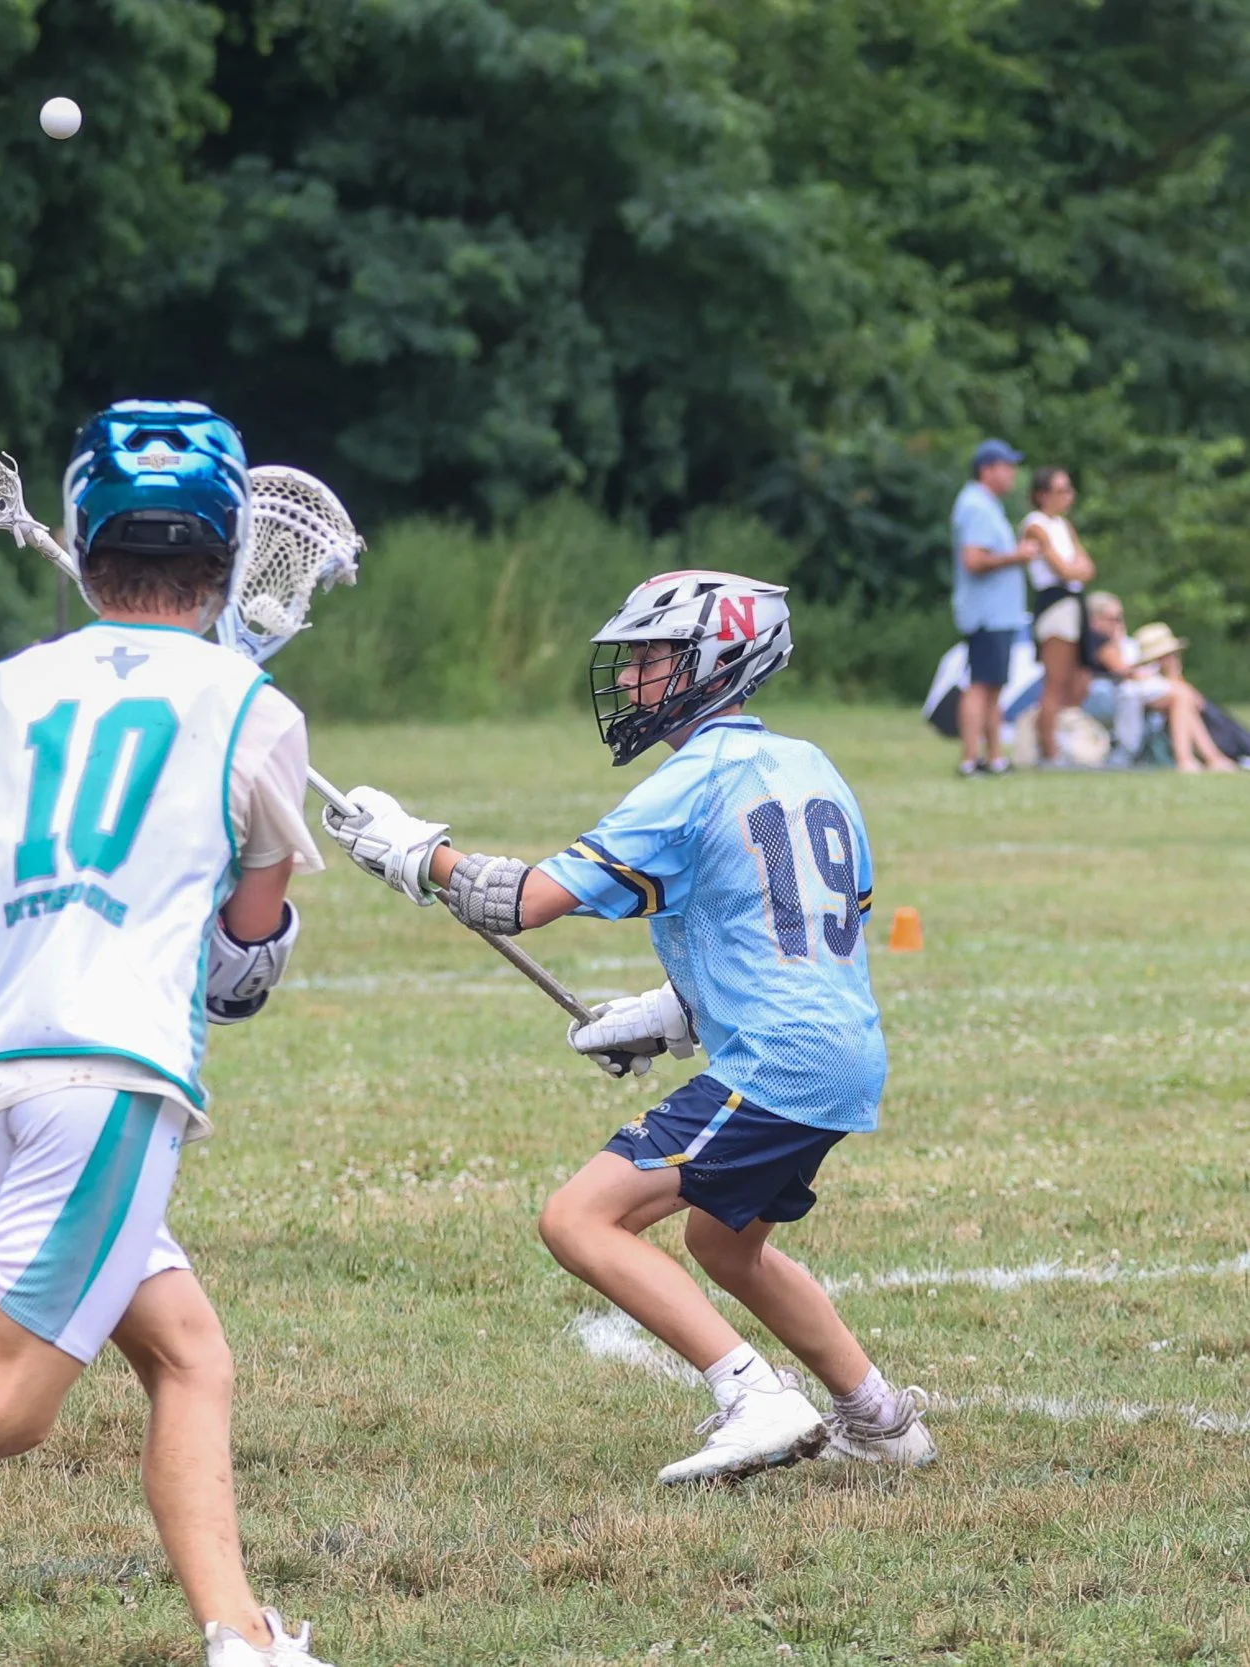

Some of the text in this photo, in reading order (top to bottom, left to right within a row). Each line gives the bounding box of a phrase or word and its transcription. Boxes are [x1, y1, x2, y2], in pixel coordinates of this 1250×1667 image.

[717, 596, 757, 641] N
[14, 697, 182, 888] 10
[740, 795, 861, 962] 19
